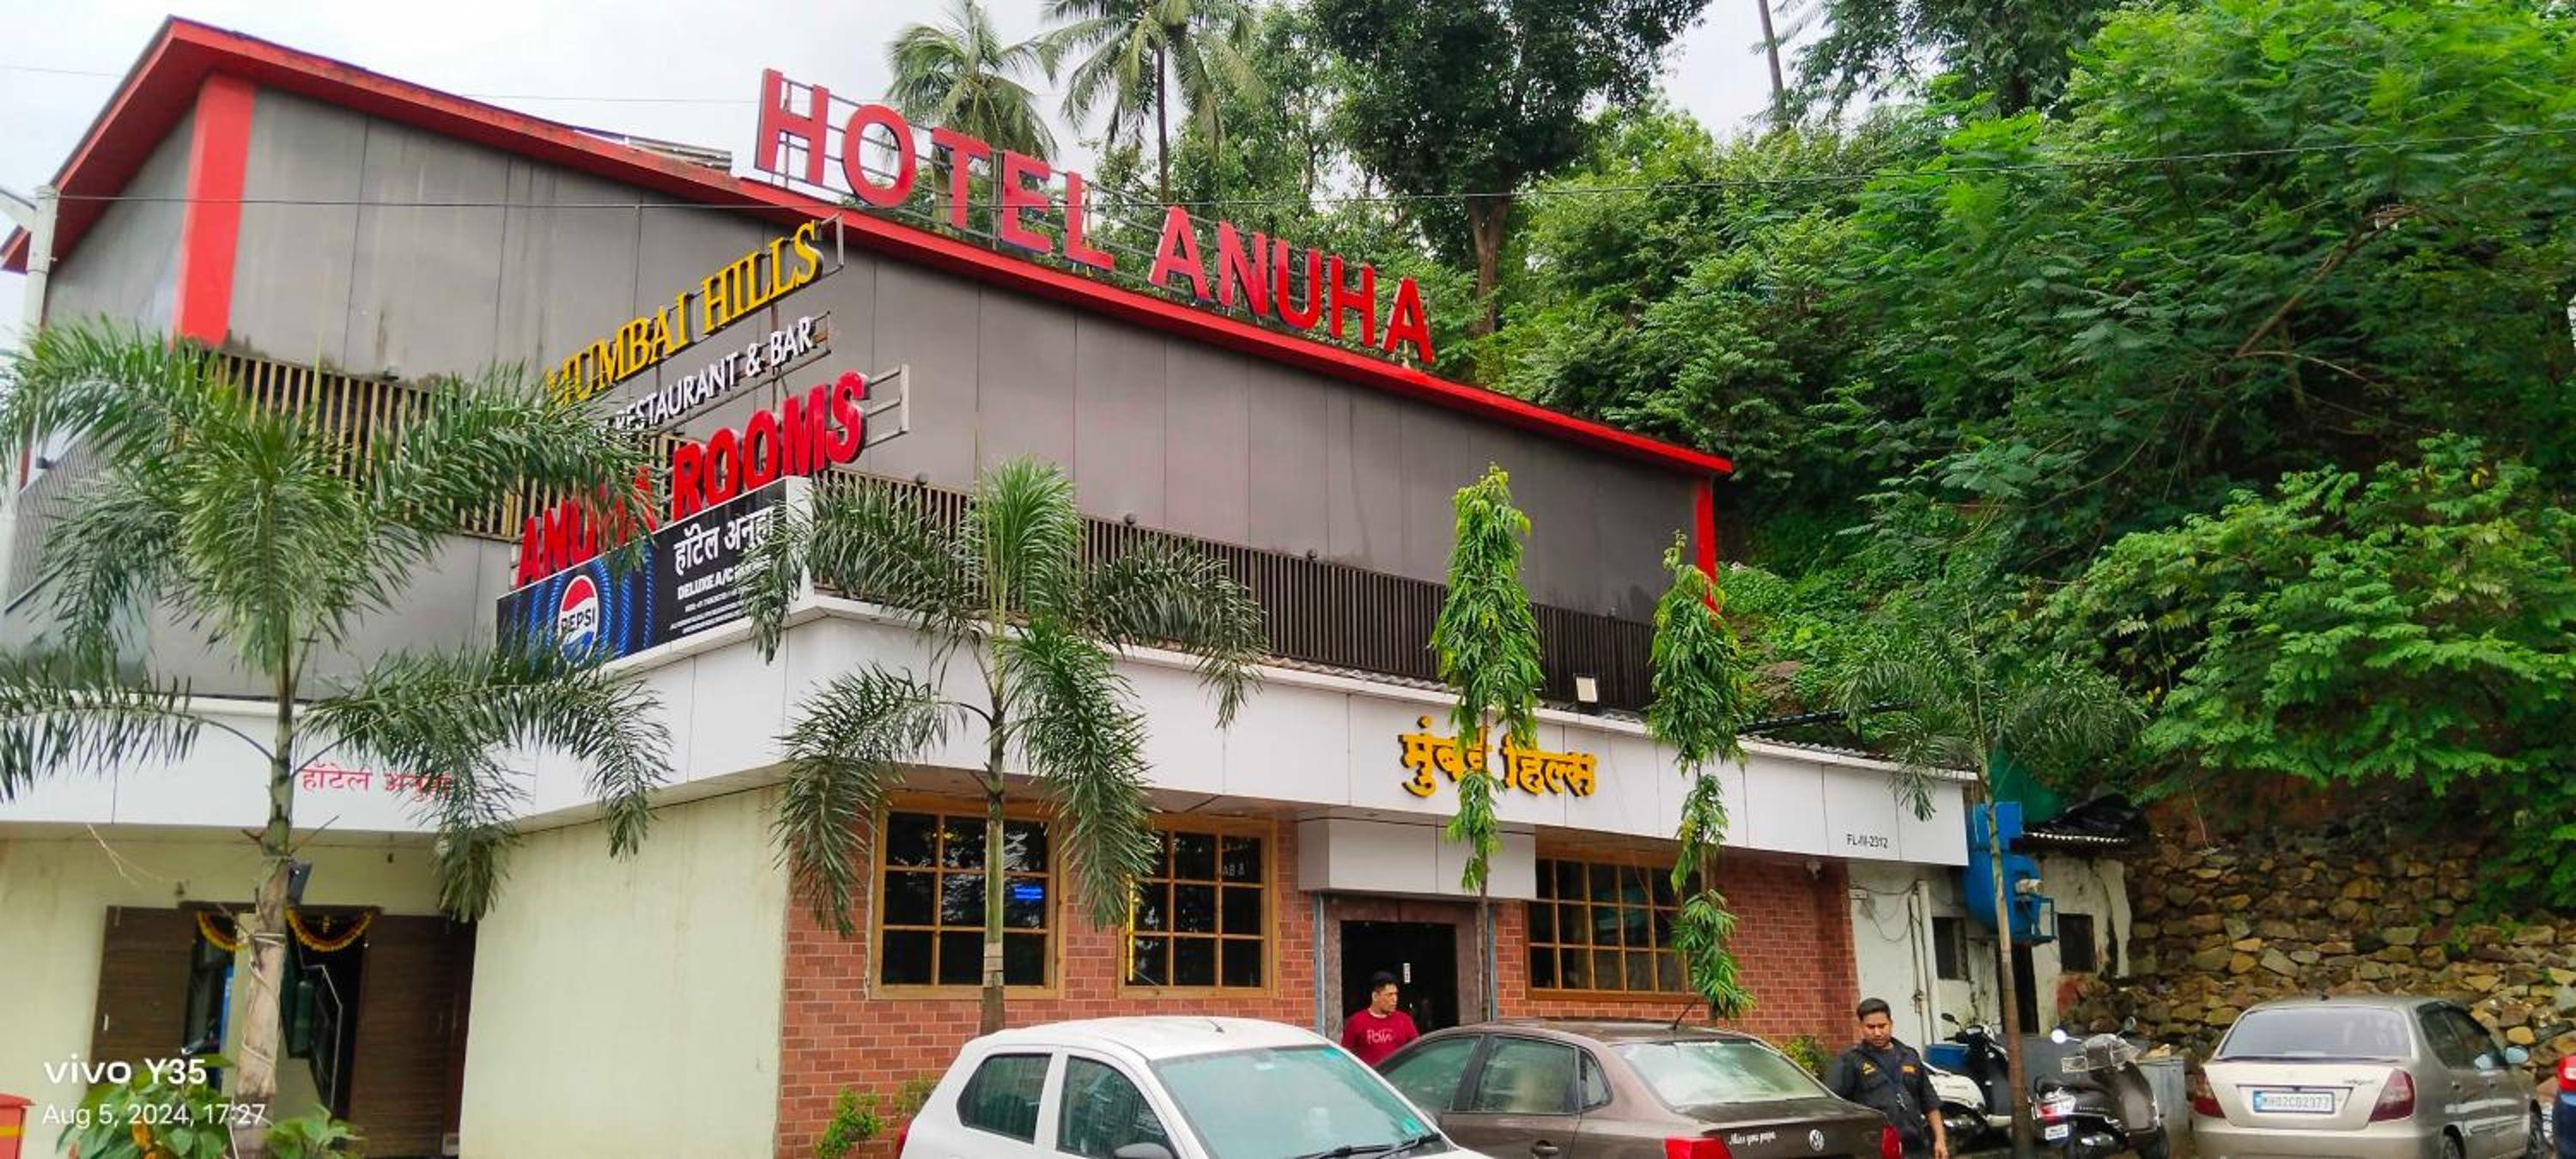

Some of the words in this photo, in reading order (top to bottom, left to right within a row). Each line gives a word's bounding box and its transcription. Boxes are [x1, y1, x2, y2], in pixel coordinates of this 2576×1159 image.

[754, 68, 1114, 271] HOTEL
[1147, 205, 1434, 364] ANUHA
[543, 291, 691, 410] MUMBAI
[701, 220, 826, 336] HILLS
[615, 351, 739, 433] RESTAURANT
[744, 342, 765, 378] &
[770, 315, 815, 367] BAR
[673, 371, 867, 522] ROOMS
